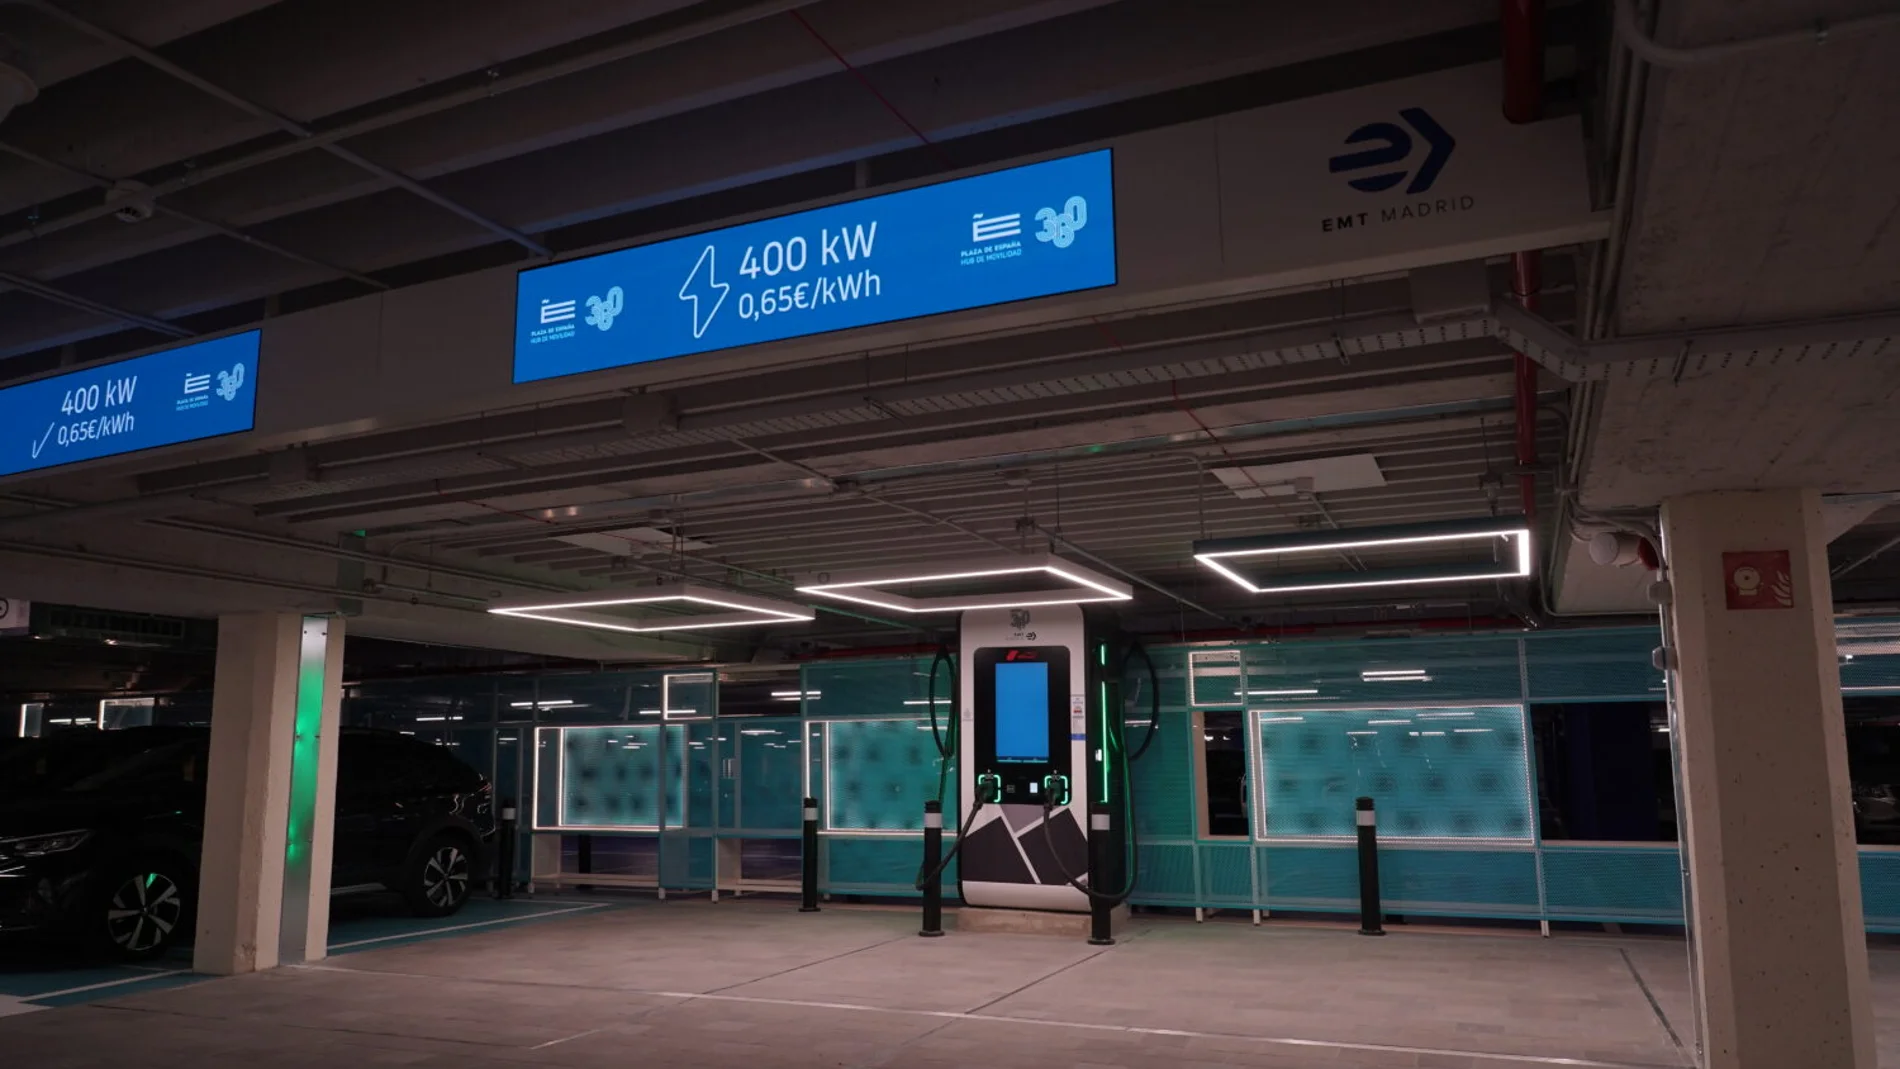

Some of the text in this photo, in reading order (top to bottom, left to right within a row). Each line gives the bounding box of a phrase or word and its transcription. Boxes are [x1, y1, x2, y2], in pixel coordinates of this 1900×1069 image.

[1321, 195, 1475, 233] EMT MADRID
[739, 221, 877, 279] 400 kW
[961, 240, 1021, 257] PLAZA DE ESPAÑA
[961, 248, 1022, 266] HUB DE MOVILIDAD
[738, 269, 881, 321] 0,65€/kWh
[61, 375, 138, 416] 400 kW
[57, 411, 135, 447] 0,65€/kWh
